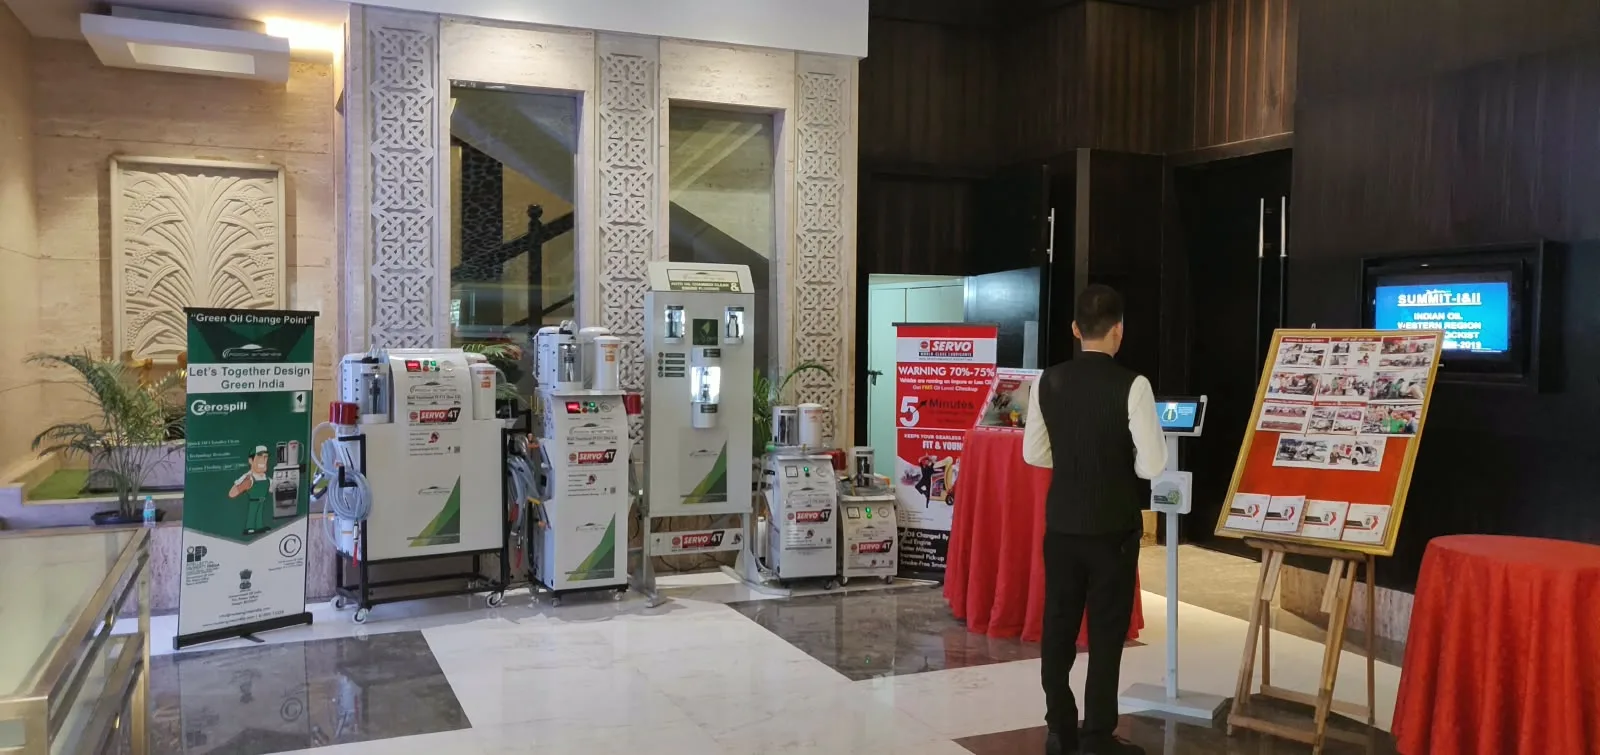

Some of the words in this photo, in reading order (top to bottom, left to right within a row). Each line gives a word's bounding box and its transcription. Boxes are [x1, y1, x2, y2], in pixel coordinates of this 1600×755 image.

[1398, 293, 1481, 304] SUMMIT-I&II
[229, 314, 243, 323] Oil
[246, 314, 281, 324] Change
[1397, 321, 1442, 330] WESTERN
[1444, 321, 1481, 329] REGION
[932, 341, 972, 352] SERVO
[189, 367, 217, 377] Let's
[222, 366, 270, 378] Together
[274, 366, 310, 377] Design
[898, 366, 946, 376] WARNING
[950, 367, 994, 376] 70%-75%
[221, 380, 255, 389] Green
[259, 379, 284, 388] India
[448, 410, 459, 418] 4T
[900, 396, 919, 427] 5
[929, 399, 974, 409] Minutes
[684, 536, 708, 544] SERVO
[711, 533, 722, 543] 4T
[859, 543, 880, 551] SERVO
[882, 542, 891, 550] 4T
